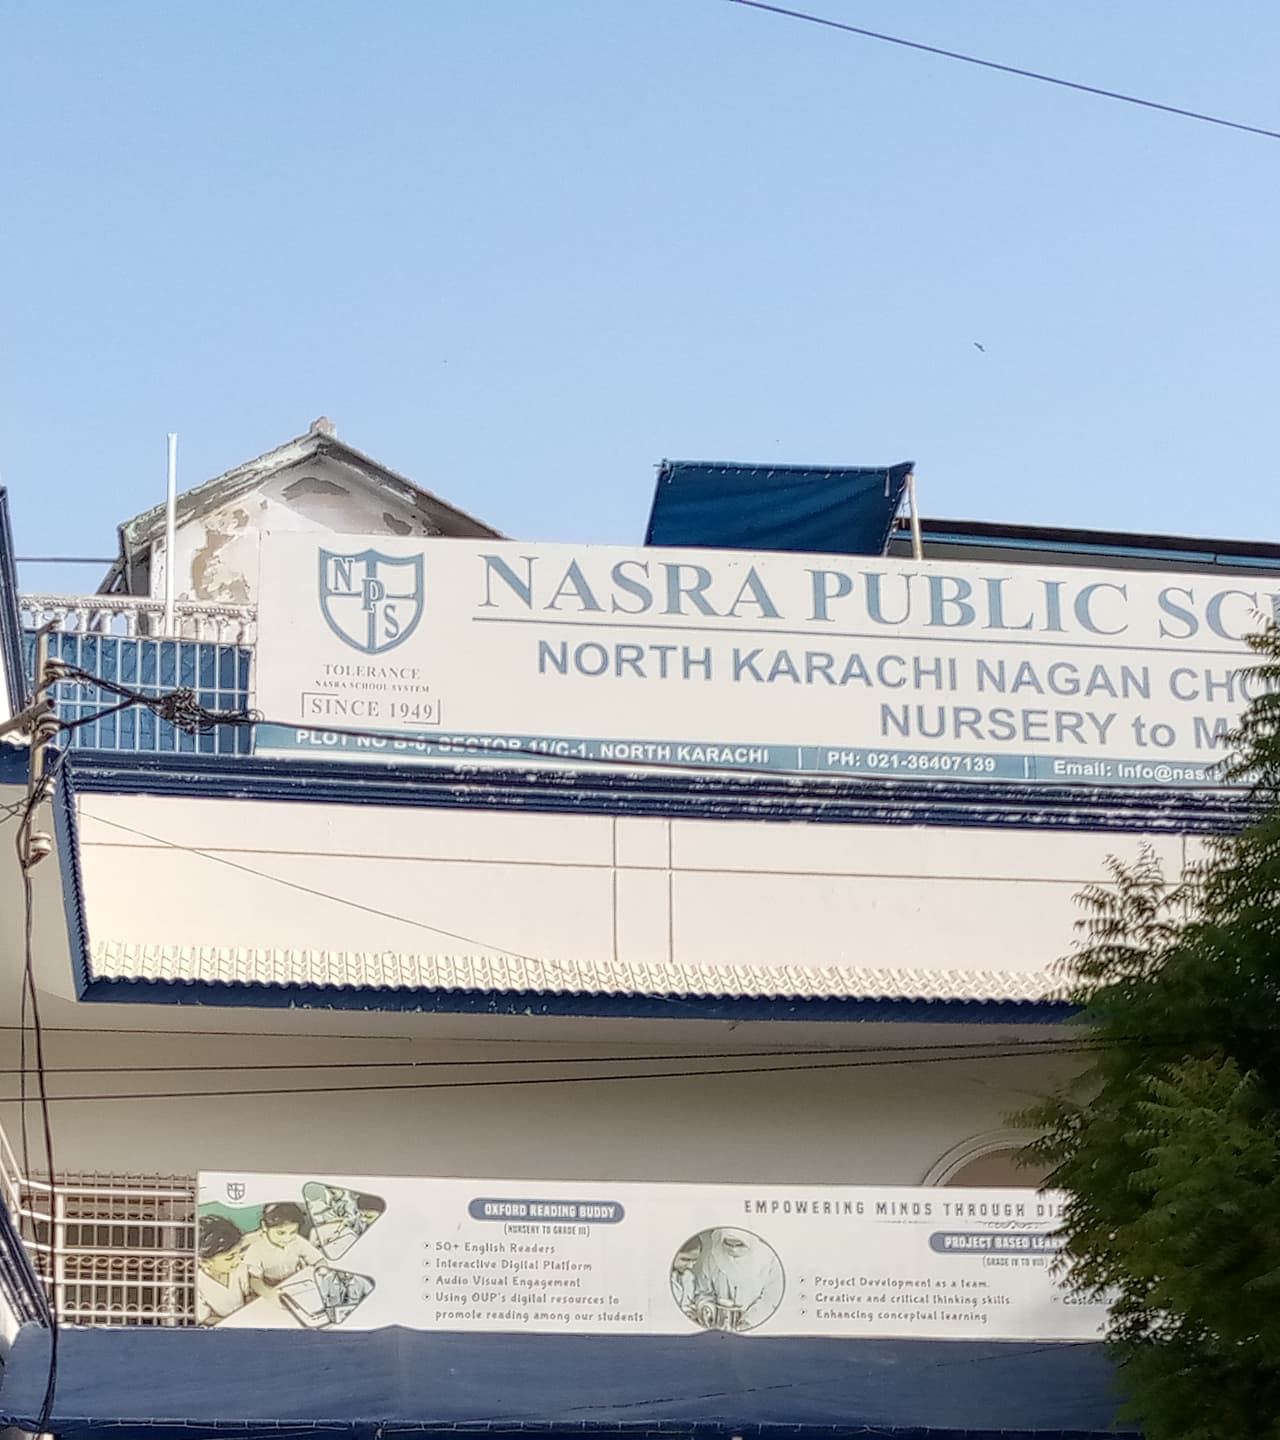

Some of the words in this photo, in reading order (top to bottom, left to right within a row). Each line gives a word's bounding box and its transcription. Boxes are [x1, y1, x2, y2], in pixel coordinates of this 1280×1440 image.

[477, 553, 785, 619] NASRA
[804, 567, 1128, 635] PUBLIC
[322, 663, 421, 681] TOLERANCE
[538, 640, 712, 680] NORTH
[732, 648, 957, 690] KARACHI
[976, 659, 1151, 700] NAGAN
[312, 698, 380, 718] SINCE
[389, 702, 433, 720] 1949
[880, 703, 1117, 745] NURSERY
[1132, 715, 1176, 749] to
[296, 729, 347, 746] PLOT
[600, 742, 670, 761] NORTH
[677, 745, 769, 765] KARACHI
[826, 751, 862, 768] PH:
[867, 752, 996, 772] 021-36407139
[1053, 760, 1112, 778] Email:
[484, 1202, 527, 1217] OXFORD
[529, 1203, 577, 1218] READING
[579, 1205, 616, 1219] BUDDY
[743, 1199, 865, 1215] EMPOWERING
[875, 1202, 933, 1216] MINDS
[943, 1203, 1026, 1217] THROUGH
[464, 1241, 506, 1255] English
[509, 1242, 556, 1254] Readers
[943, 1235, 992, 1250] PROJECT
[995, 1236, 1031, 1250] BASED
[435, 1258, 498, 1270] Interactive
[501, 1259, 539, 1273] Digital
[543, 1260, 593, 1271] Platform
[435, 1274, 469, 1286] Audio
[472, 1276, 508, 1287] Visual
[512, 1276, 581, 1290] Engagement
